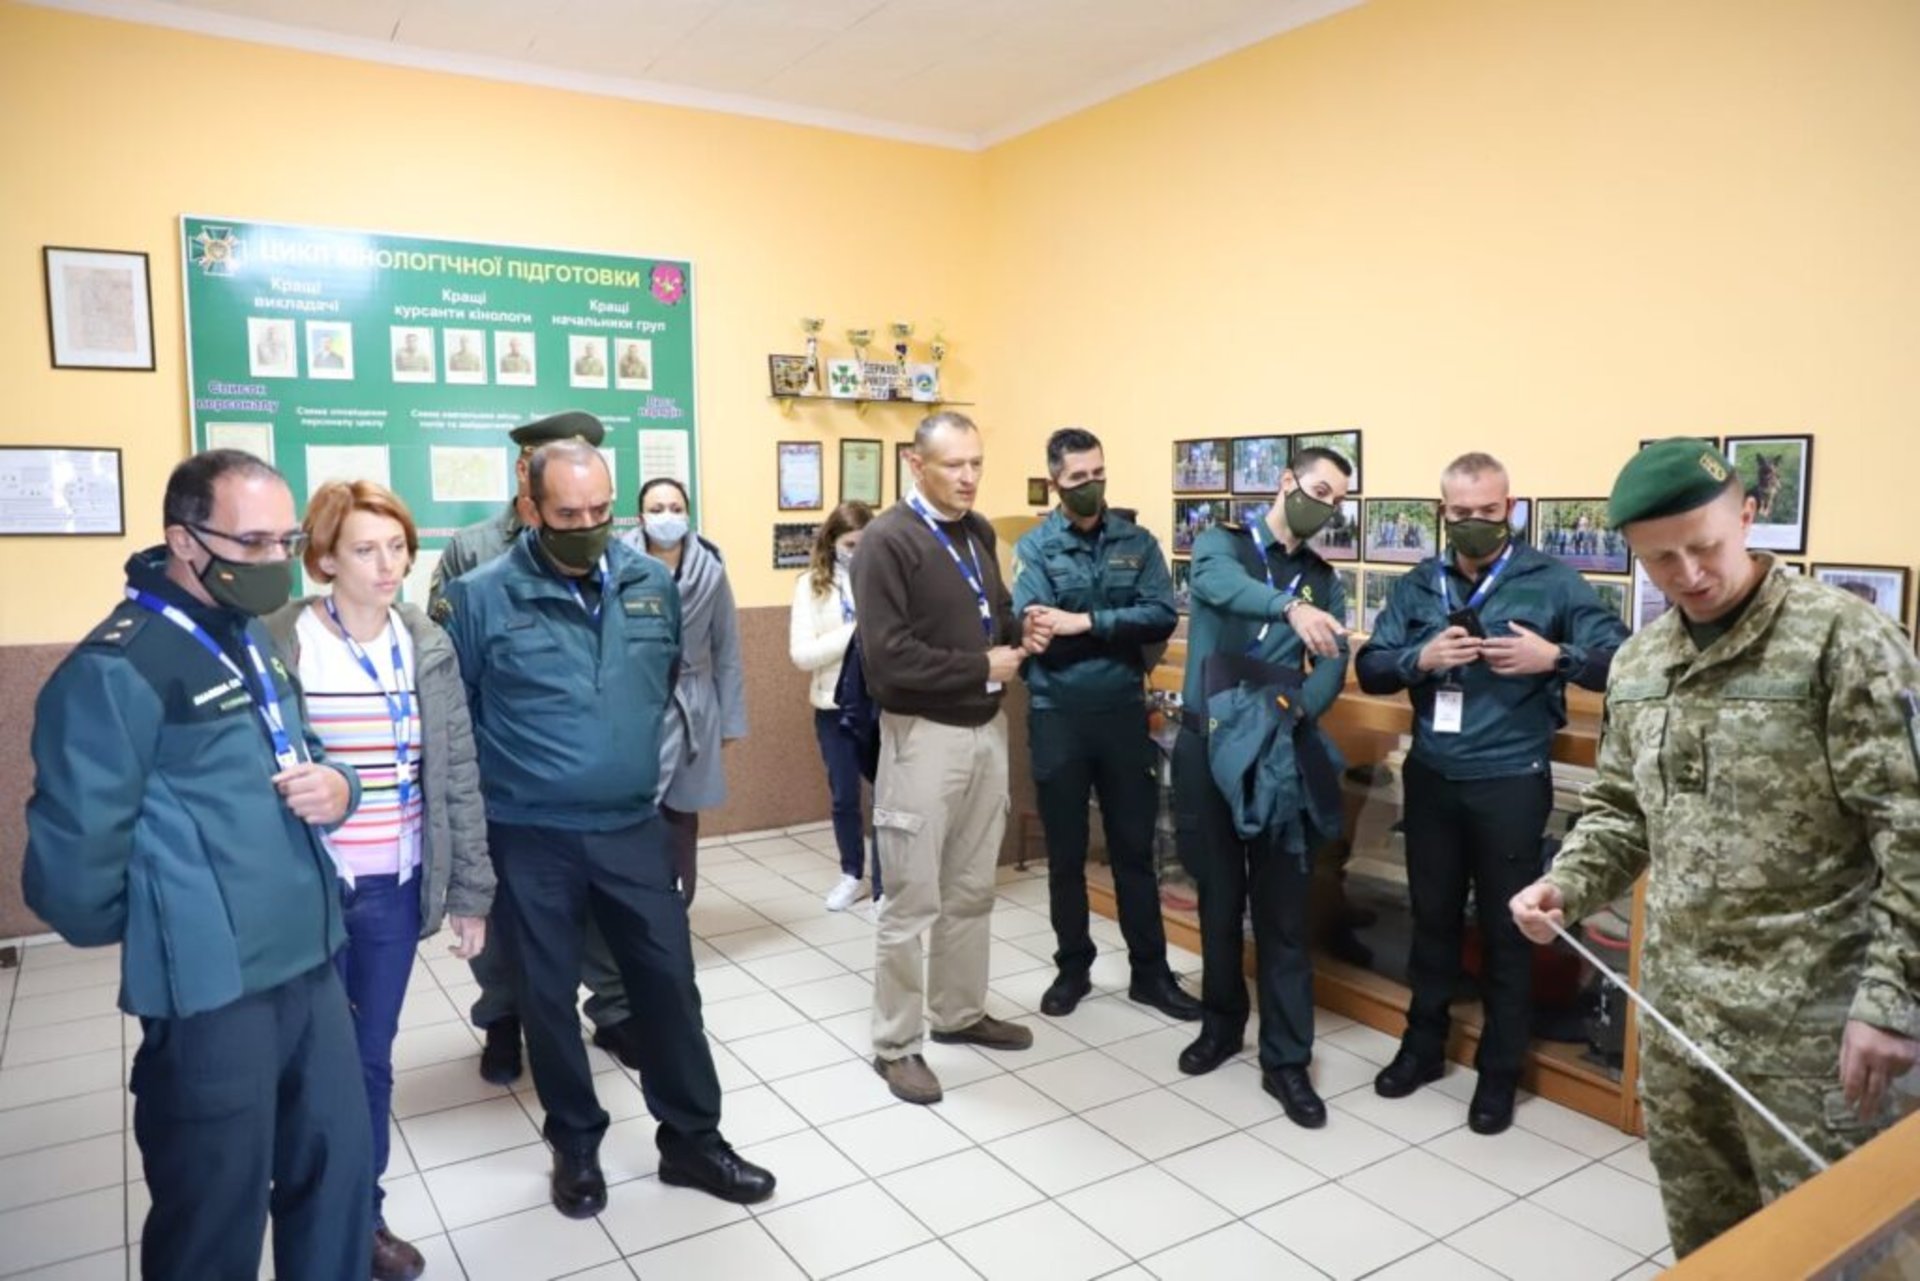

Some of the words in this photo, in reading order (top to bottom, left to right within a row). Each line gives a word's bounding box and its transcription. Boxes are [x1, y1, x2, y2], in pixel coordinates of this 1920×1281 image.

[337, 245, 501, 275] НОЛОГІЧНОЇ
[508, 260, 641, 289] ПІДГОТОВКИ
[441, 288, 487, 305] Кращі
[394, 304, 465, 320] курсанти
[468, 308, 532, 323] кінологи
[589, 298, 630, 315] Кращі
[552, 314, 633, 331] начальники
[636, 320, 667, 334] груп
